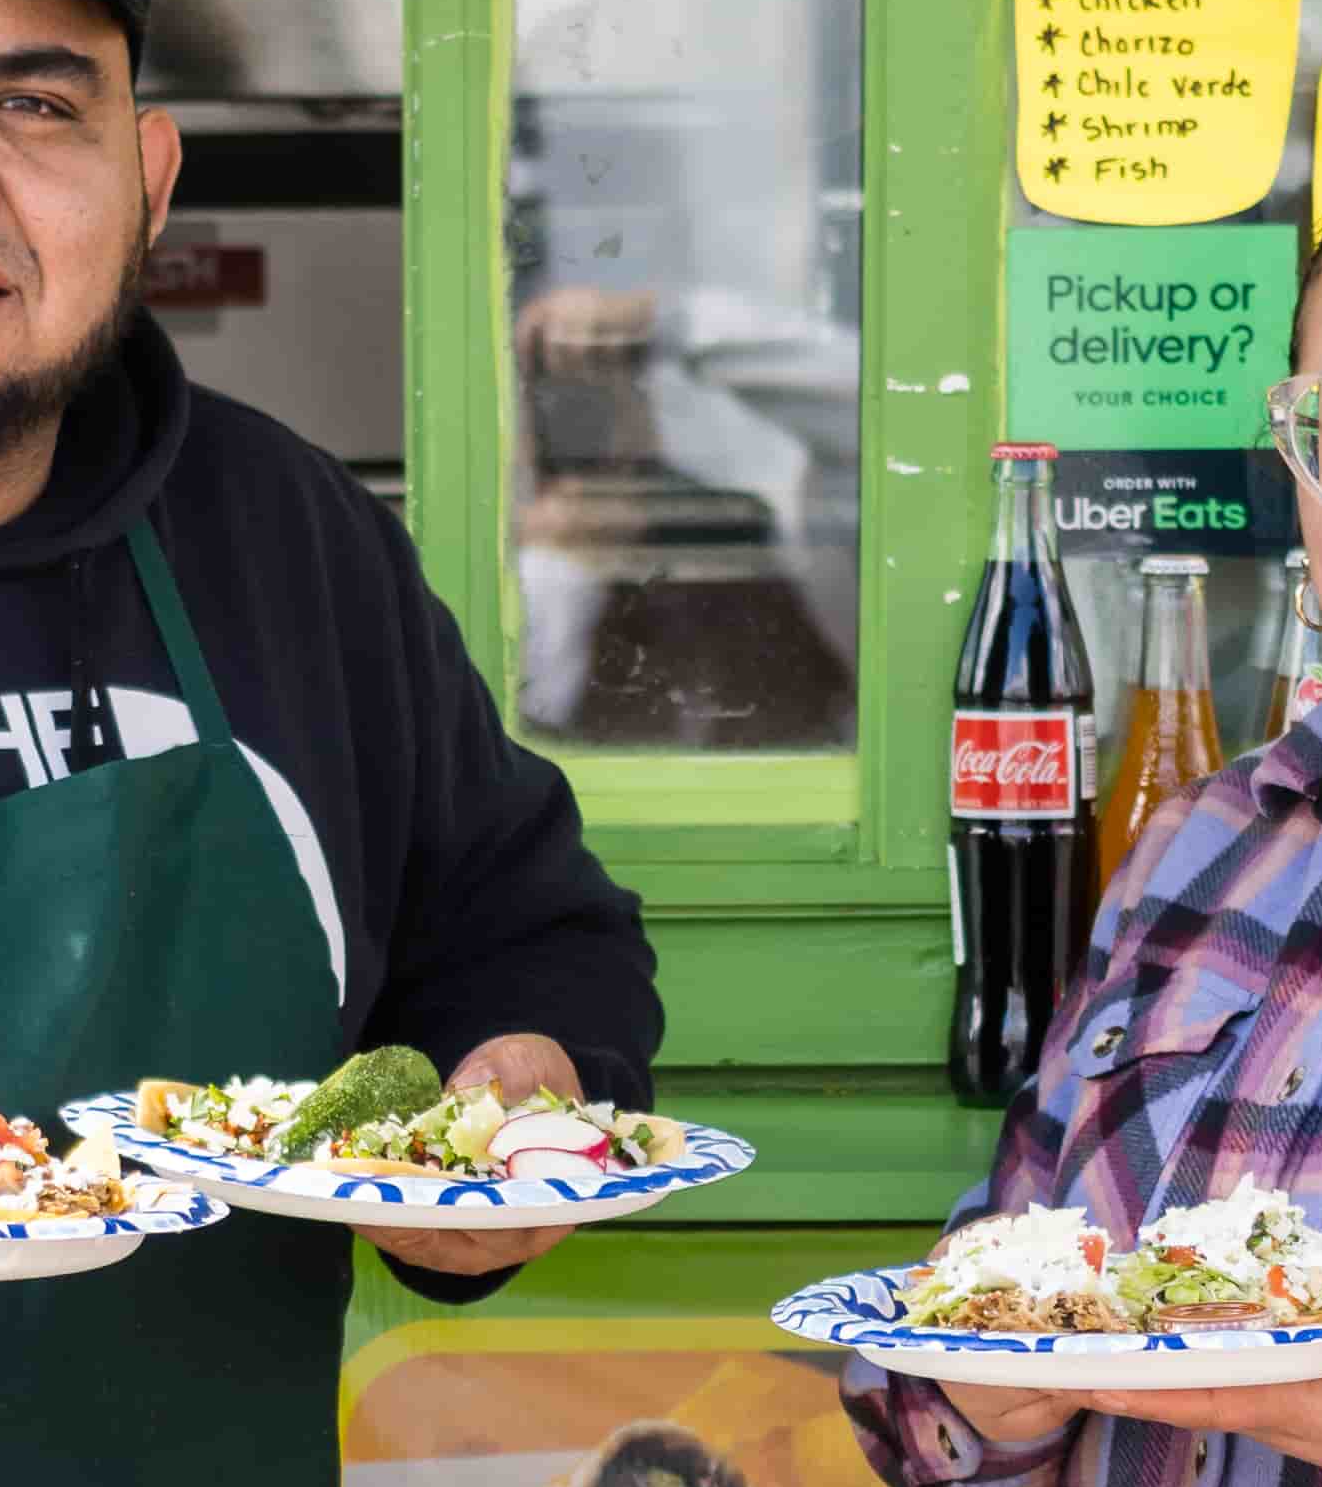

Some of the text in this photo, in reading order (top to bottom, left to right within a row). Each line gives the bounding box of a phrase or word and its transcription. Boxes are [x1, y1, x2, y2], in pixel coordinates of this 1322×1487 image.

[1094, 156, 1169, 181] Fish
[1046, 273, 1257, 323] Pickup or
[1049, 322, 1255, 374] delivery?
[1074, 389, 1228, 407] YOUR CHOICE
[1102, 476, 1197, 492] ORDER WITH
[1053, 495, 1248, 532] Uber Eats
[954, 738, 1066, 787] Coca-Cola
